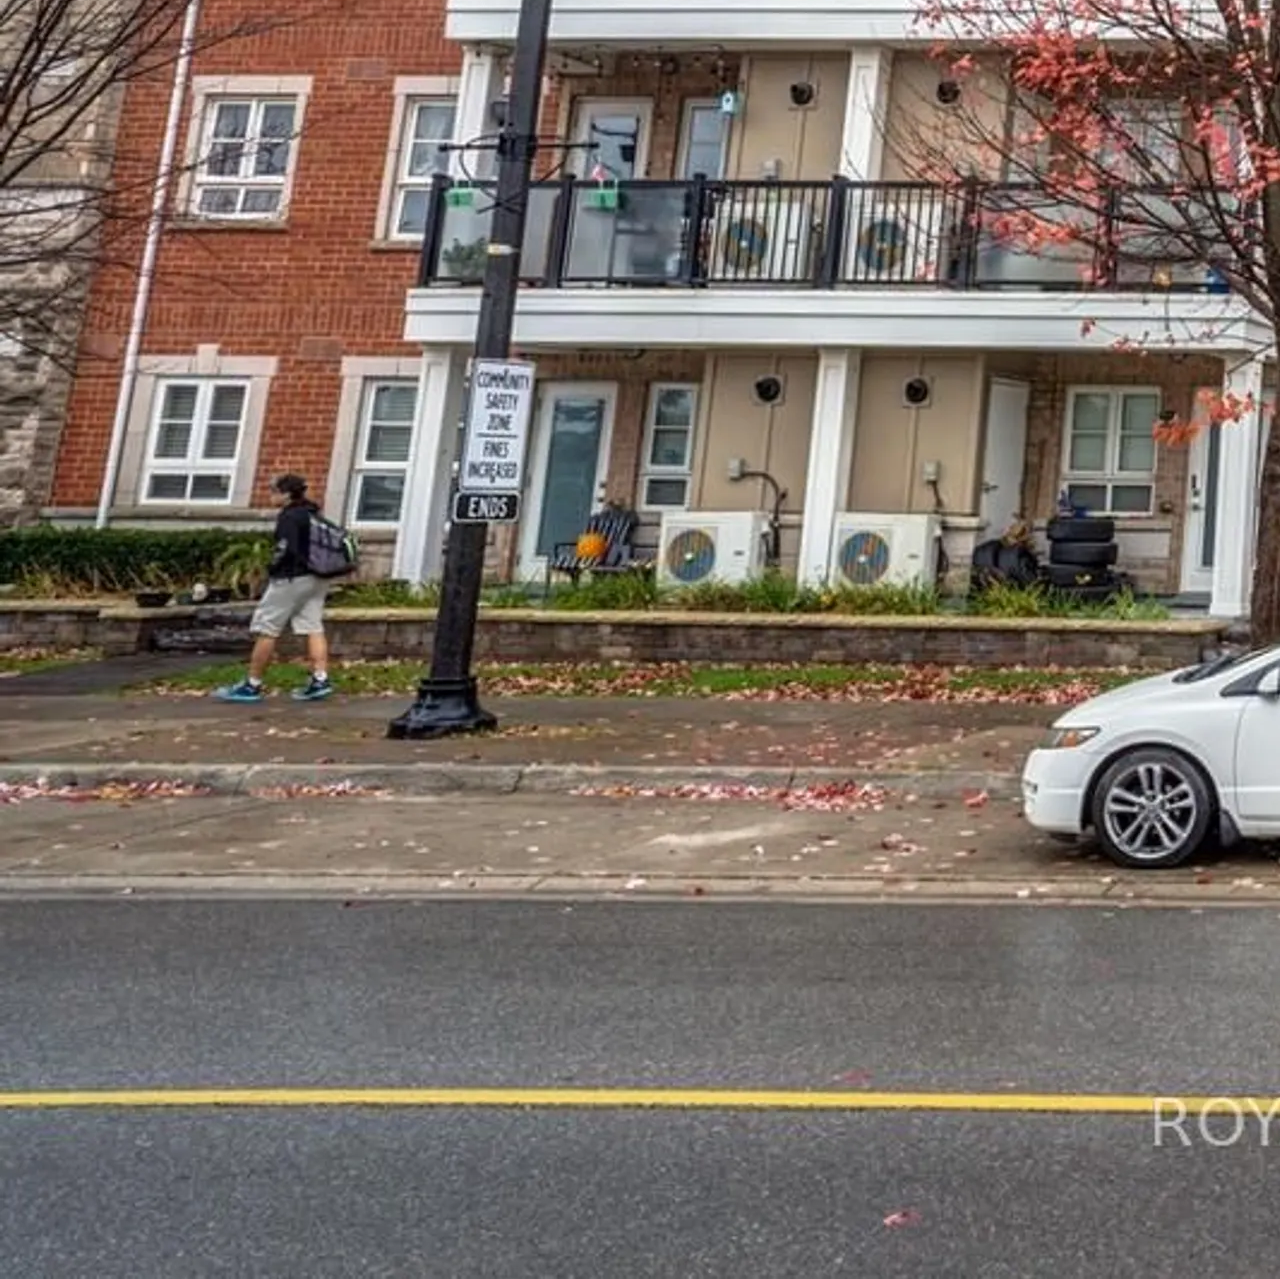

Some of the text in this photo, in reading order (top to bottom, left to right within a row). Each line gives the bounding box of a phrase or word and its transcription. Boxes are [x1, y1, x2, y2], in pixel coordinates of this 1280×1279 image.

[477, 371, 529, 389] COMMUNITY
[485, 392, 519, 411] SAFETY
[487, 413, 512, 431] ZONE
[482, 440, 510, 458] FINES
[467, 461, 517, 479] INCREASED
[467, 496, 508, 518] ENDS
